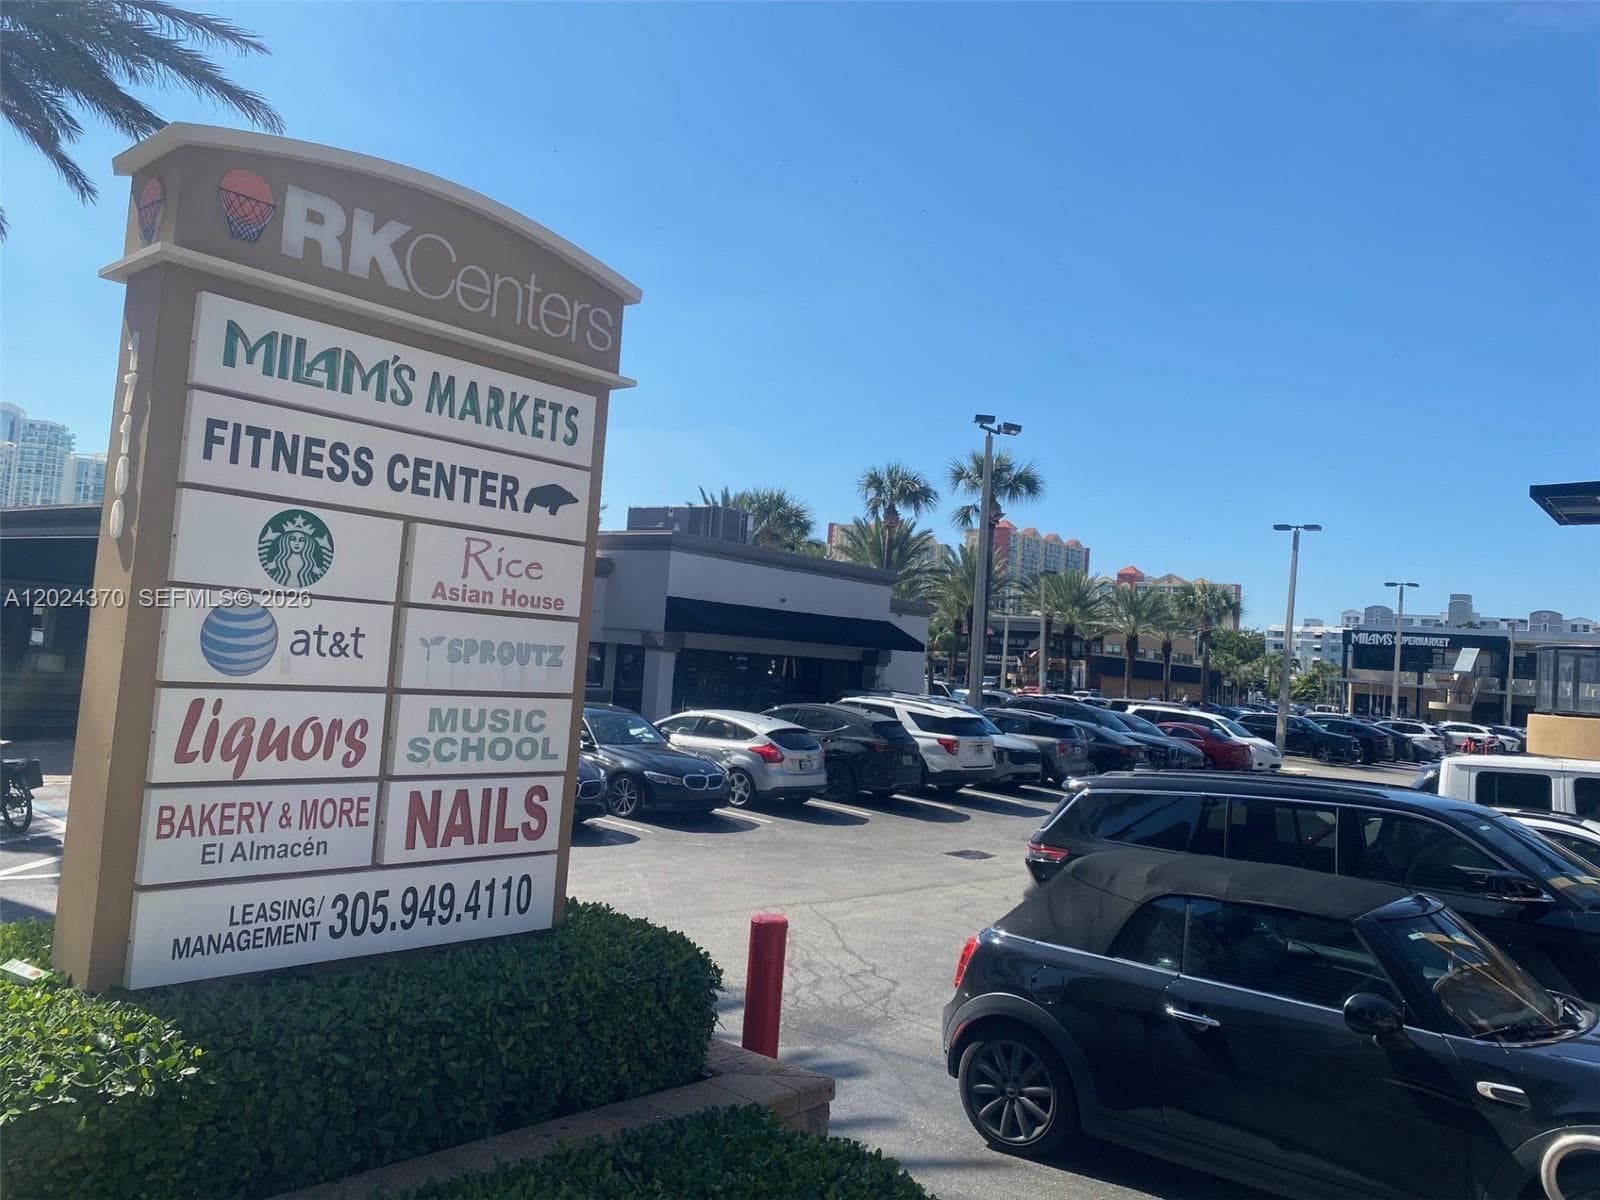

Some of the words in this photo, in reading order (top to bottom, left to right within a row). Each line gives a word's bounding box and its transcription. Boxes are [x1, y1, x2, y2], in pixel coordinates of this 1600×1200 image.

[222, 319, 416, 407] MILAM'S
[425, 371, 580, 447] MARKETS
[202, 417, 374, 487] FITNESS
[386, 453, 519, 512] CENTER
[461, 536, 543, 581] Rice
[430, 581, 494, 604] Asian
[502, 588, 565, 611] House
[289, 624, 366, 659] at&t
[447, 638, 565, 668] SPROUTZ
[174, 697, 369, 780] Liquors
[427, 708, 547, 734] MUSIC
[406, 737, 559, 763] SCHOOL
[155, 801, 273, 840] BAKERY
[278, 802, 292, 829] &
[298, 796, 371, 831] MORE
[404, 785, 549, 851] NAILS
[201, 843, 224, 865] El
[230, 836, 329, 863] Almacén
[228, 895, 325, 926] LEASING/
[328, 873, 533, 940] 305.949.4110
[171, 921, 321, 960] MANAGEMENT
